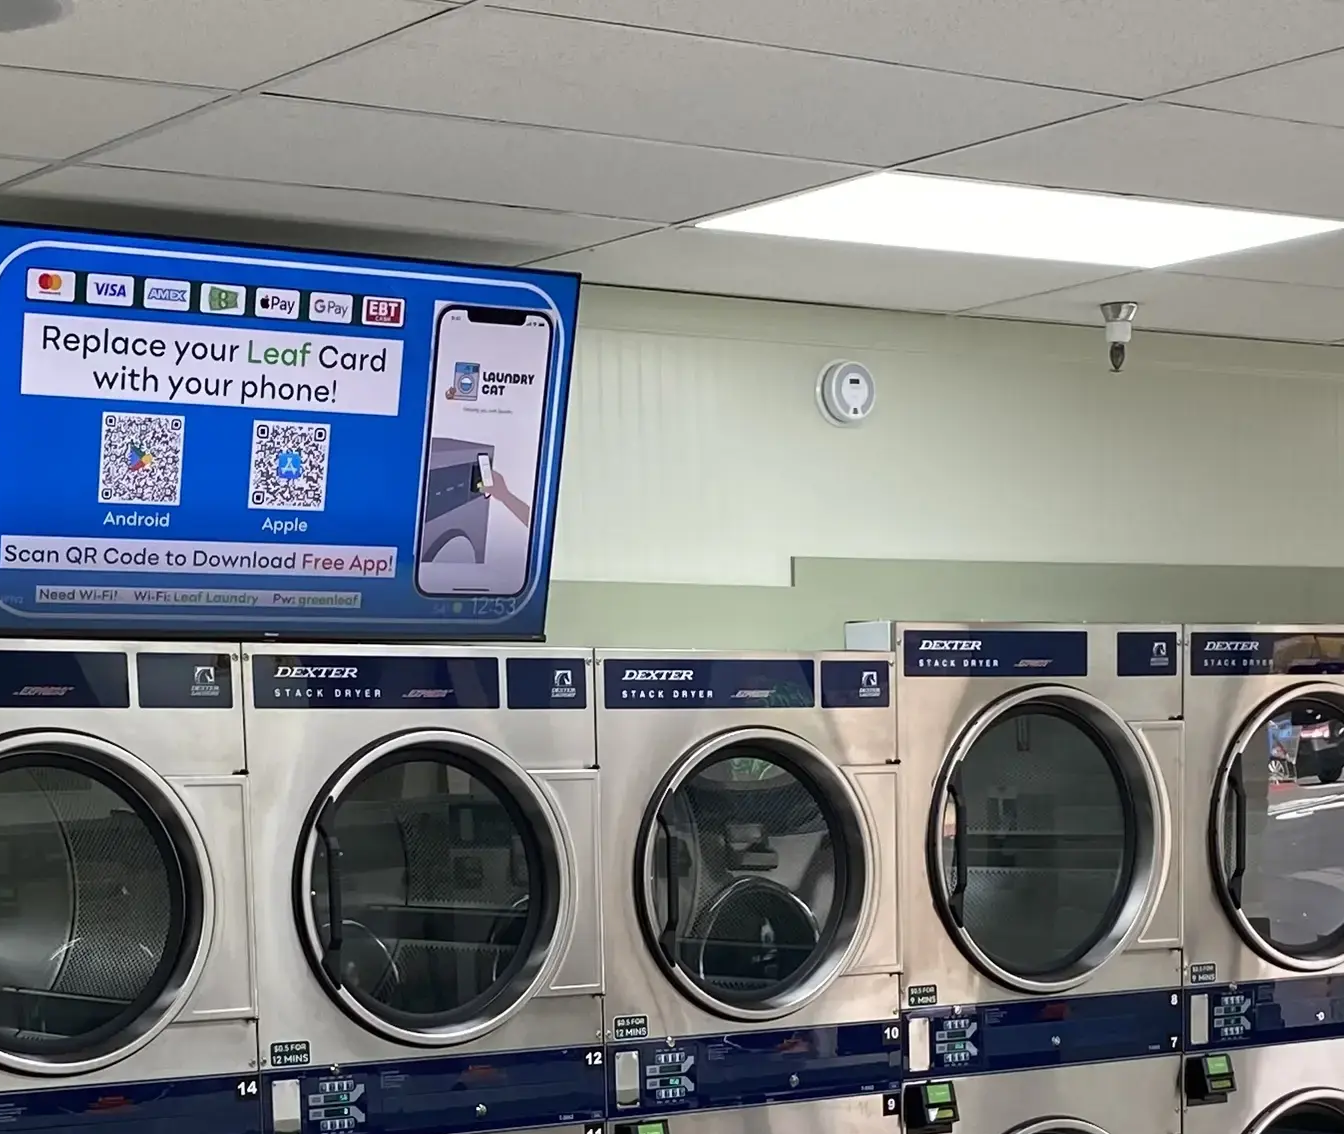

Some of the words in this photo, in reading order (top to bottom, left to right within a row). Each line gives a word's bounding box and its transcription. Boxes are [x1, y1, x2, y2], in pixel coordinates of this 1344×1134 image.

[94, 282, 127, 298] VISA
[147, 287, 187, 302] AMEX
[271, 296, 295, 314] Pay
[369, 301, 398, 317] EBT
[42, 325, 166, 359] Replace
[174, 340, 240, 366] your
[247, 340, 312, 367] Leaf
[318, 345, 388, 372] Card
[482, 371, 536, 385] LAUNDRY
[92, 365, 158, 392] with
[168, 374, 233, 400] your
[241, 375, 338, 404] phone!
[481, 384, 506, 396] CAT
[102, 511, 171, 528] Android
[261, 517, 308, 534] Apple
[4, 544, 60, 564] Scan
[65, 545, 97, 566] QR
[103, 547, 160, 567] Code
[166, 550, 187, 568] to
[192, 550, 297, 570] Download
[302, 553, 345, 571] Free
[348, 554, 395, 576] App!
[39, 588, 76, 601] Need
[173, 590, 204, 604] Leaf
[206, 591, 259, 606] Laundry
[272, 593, 296, 606] Pw:
[298, 593, 360, 608] greenleaf
[471, 597, 517, 615] 12:53
[918, 640, 983, 651] DEXTER
[1204, 641, 1260, 651] DEXTER
[918, 659, 956, 668] STACK
[963, 659, 1000, 668] DRYER
[1203, 658, 1237, 667] STACK
[273, 666, 358, 678] DEXTER
[621, 669, 694, 680] DEXTER
[274, 688, 325, 698] STACK
[335, 688, 382, 698] DRYER
[622, 690, 665, 699] STACK
[673, 690, 714, 699] DRYER
[917, 995, 936, 1004] MINS
[1170, 993, 1178, 1005] 8
[631, 1017, 645, 1025] FOR
[615, 1028, 625, 1037] 12
[625, 1027, 647, 1037] MINS
[883, 1026, 899, 1040] 10
[291, 1043, 307, 1051] FOR
[1170, 1036, 1178, 1048] 7
[272, 1056, 283, 1064] 12
[284, 1053, 309, 1064] MINS
[585, 1051, 603, 1065] 12
[237, 1080, 258, 1096] 14
[887, 1098, 896, 1110] 9
